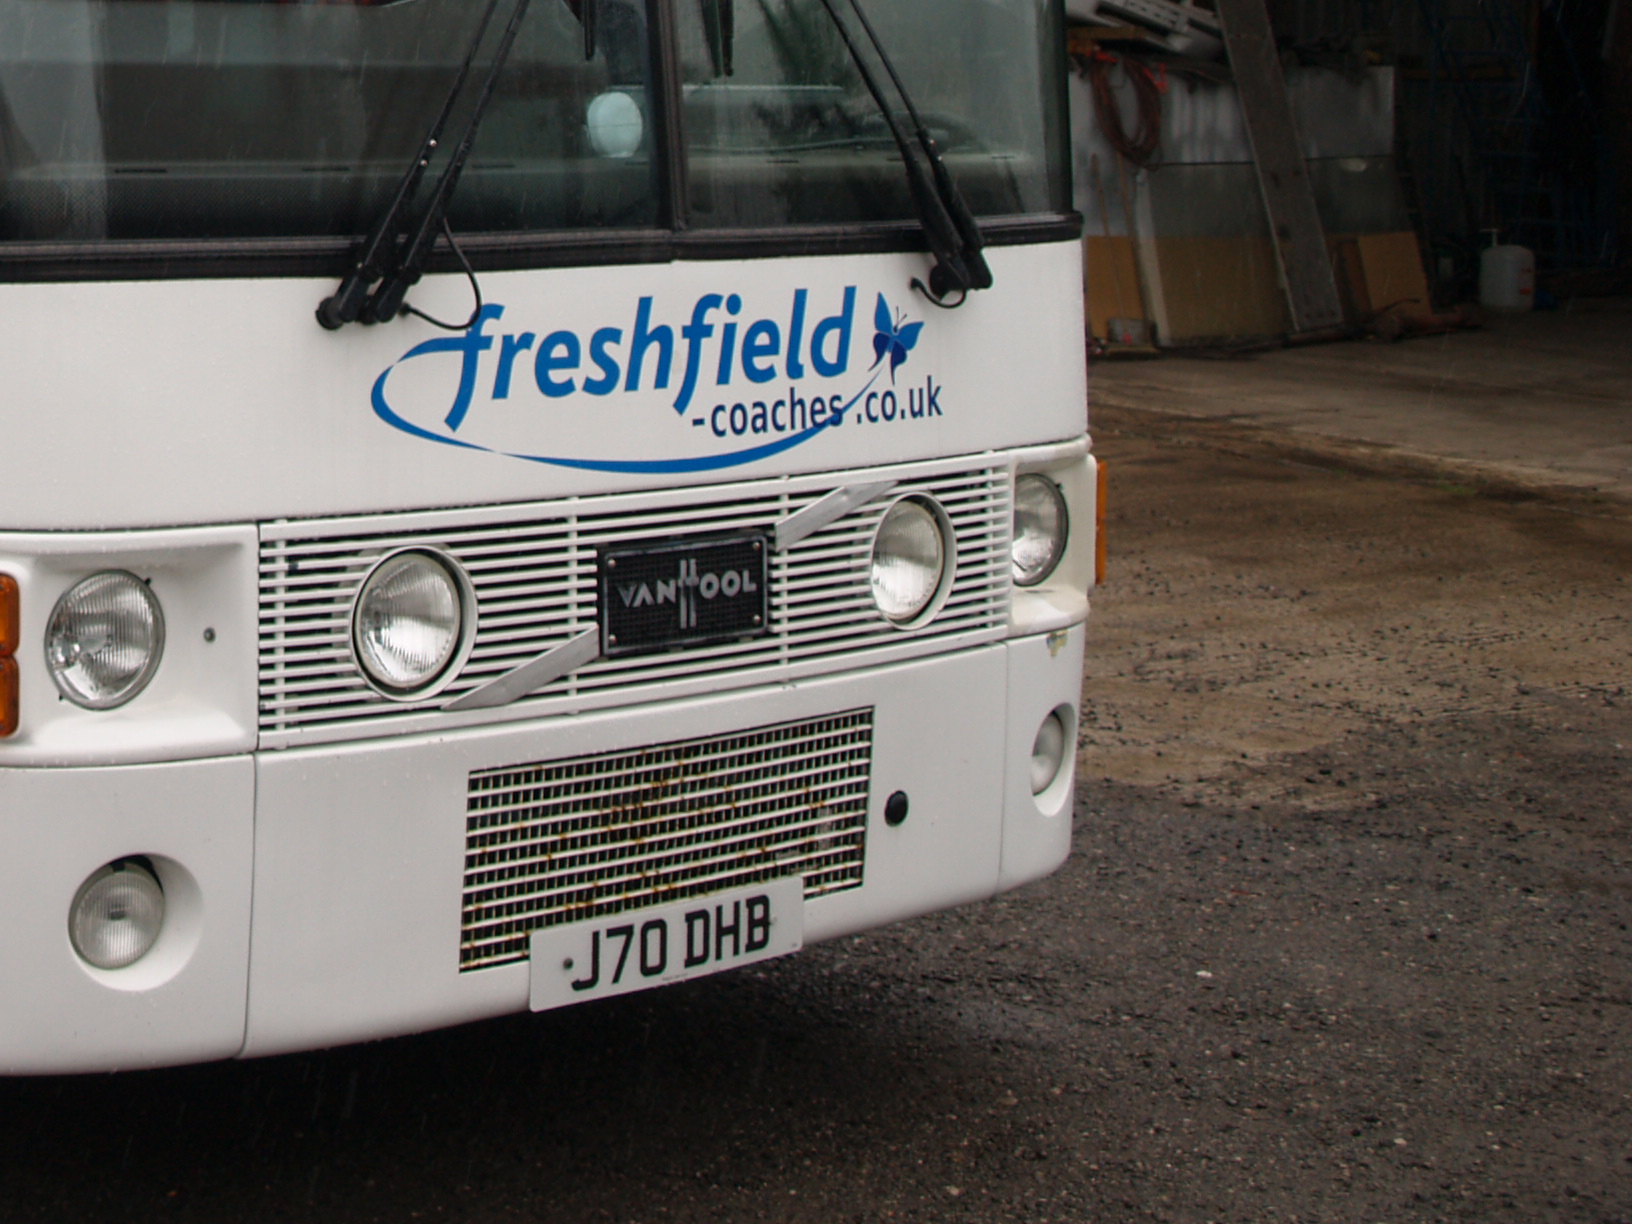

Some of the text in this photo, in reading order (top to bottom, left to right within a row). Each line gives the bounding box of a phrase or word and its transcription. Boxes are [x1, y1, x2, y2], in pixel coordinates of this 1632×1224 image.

[442, 285, 857, 432] freshfield
[571, 894, 770, 992] J70 DHB
